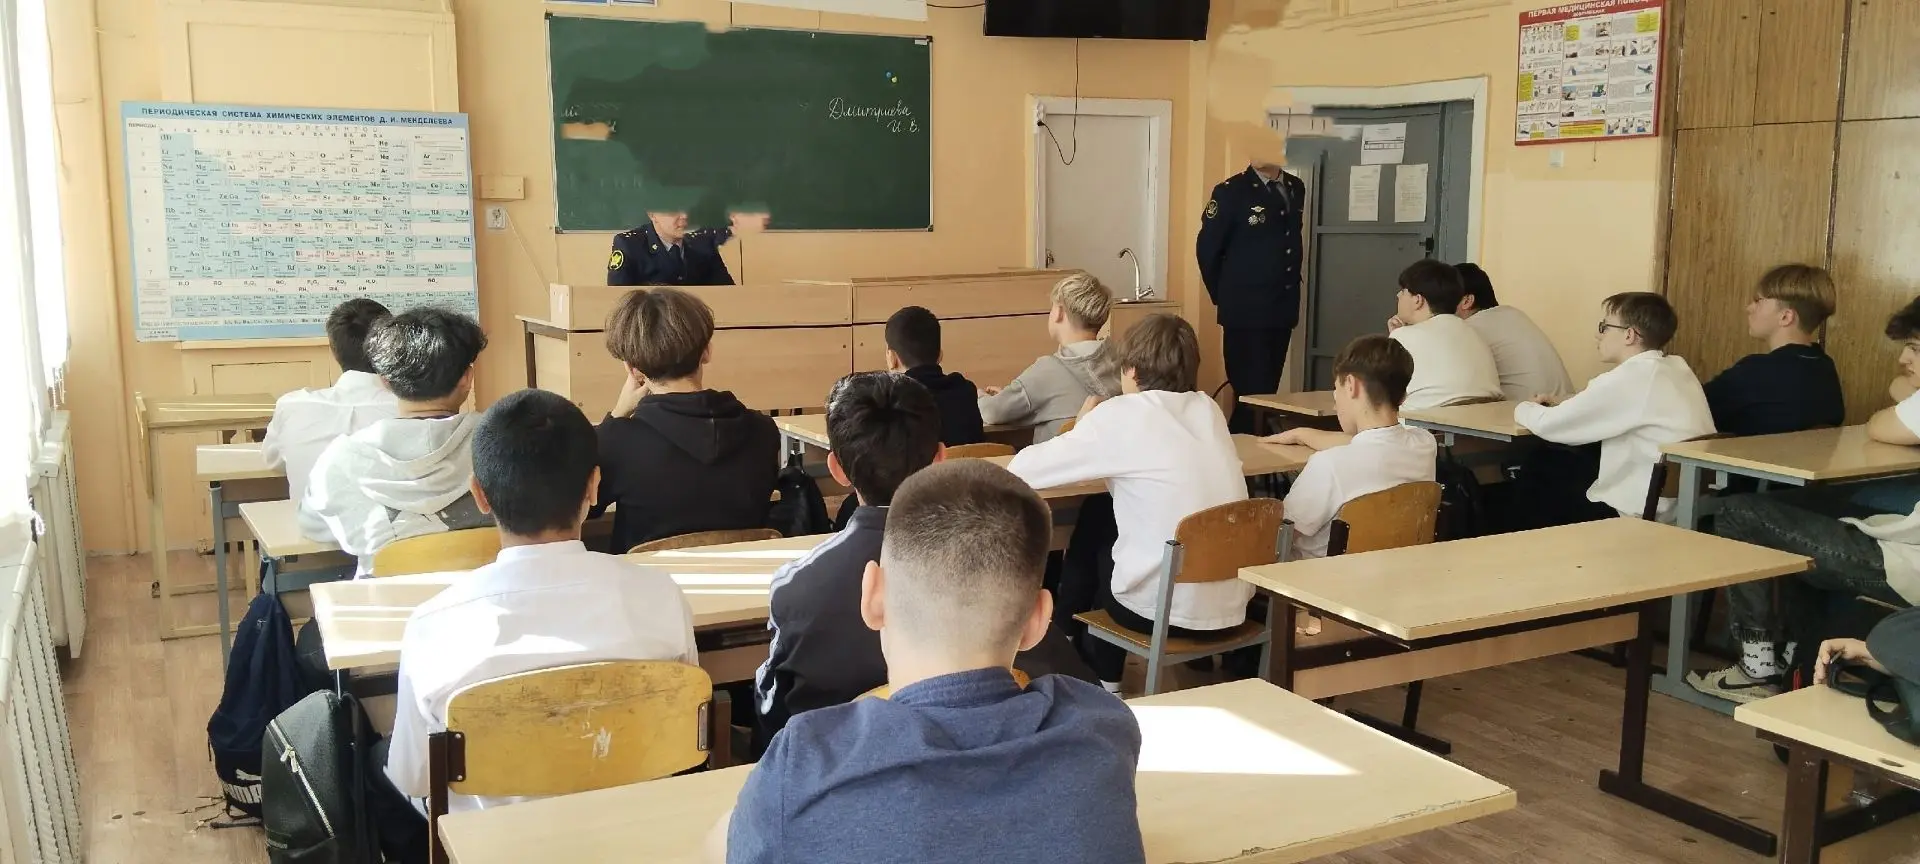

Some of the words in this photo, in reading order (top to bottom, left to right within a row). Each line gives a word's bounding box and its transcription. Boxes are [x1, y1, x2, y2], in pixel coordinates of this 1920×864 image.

[1528, 7, 1556, 18] ПЕРВАЯ
[1557, 0, 1615, 13] МЕДИЦИНСКАЯ
[141, 107, 217, 117] ПЕРИОДИЧЕСКАЯ
[222, 110, 262, 118] СИСТЕМА
[266, 112, 323, 121] ХИМИЧЕСКИХ
[326, 114, 376, 122] ЭЛЕМЕНТОВ
[400, 116, 453, 125] МЕНДЕЛЕЕВА
[829, 97, 912, 124] Дмитриева
